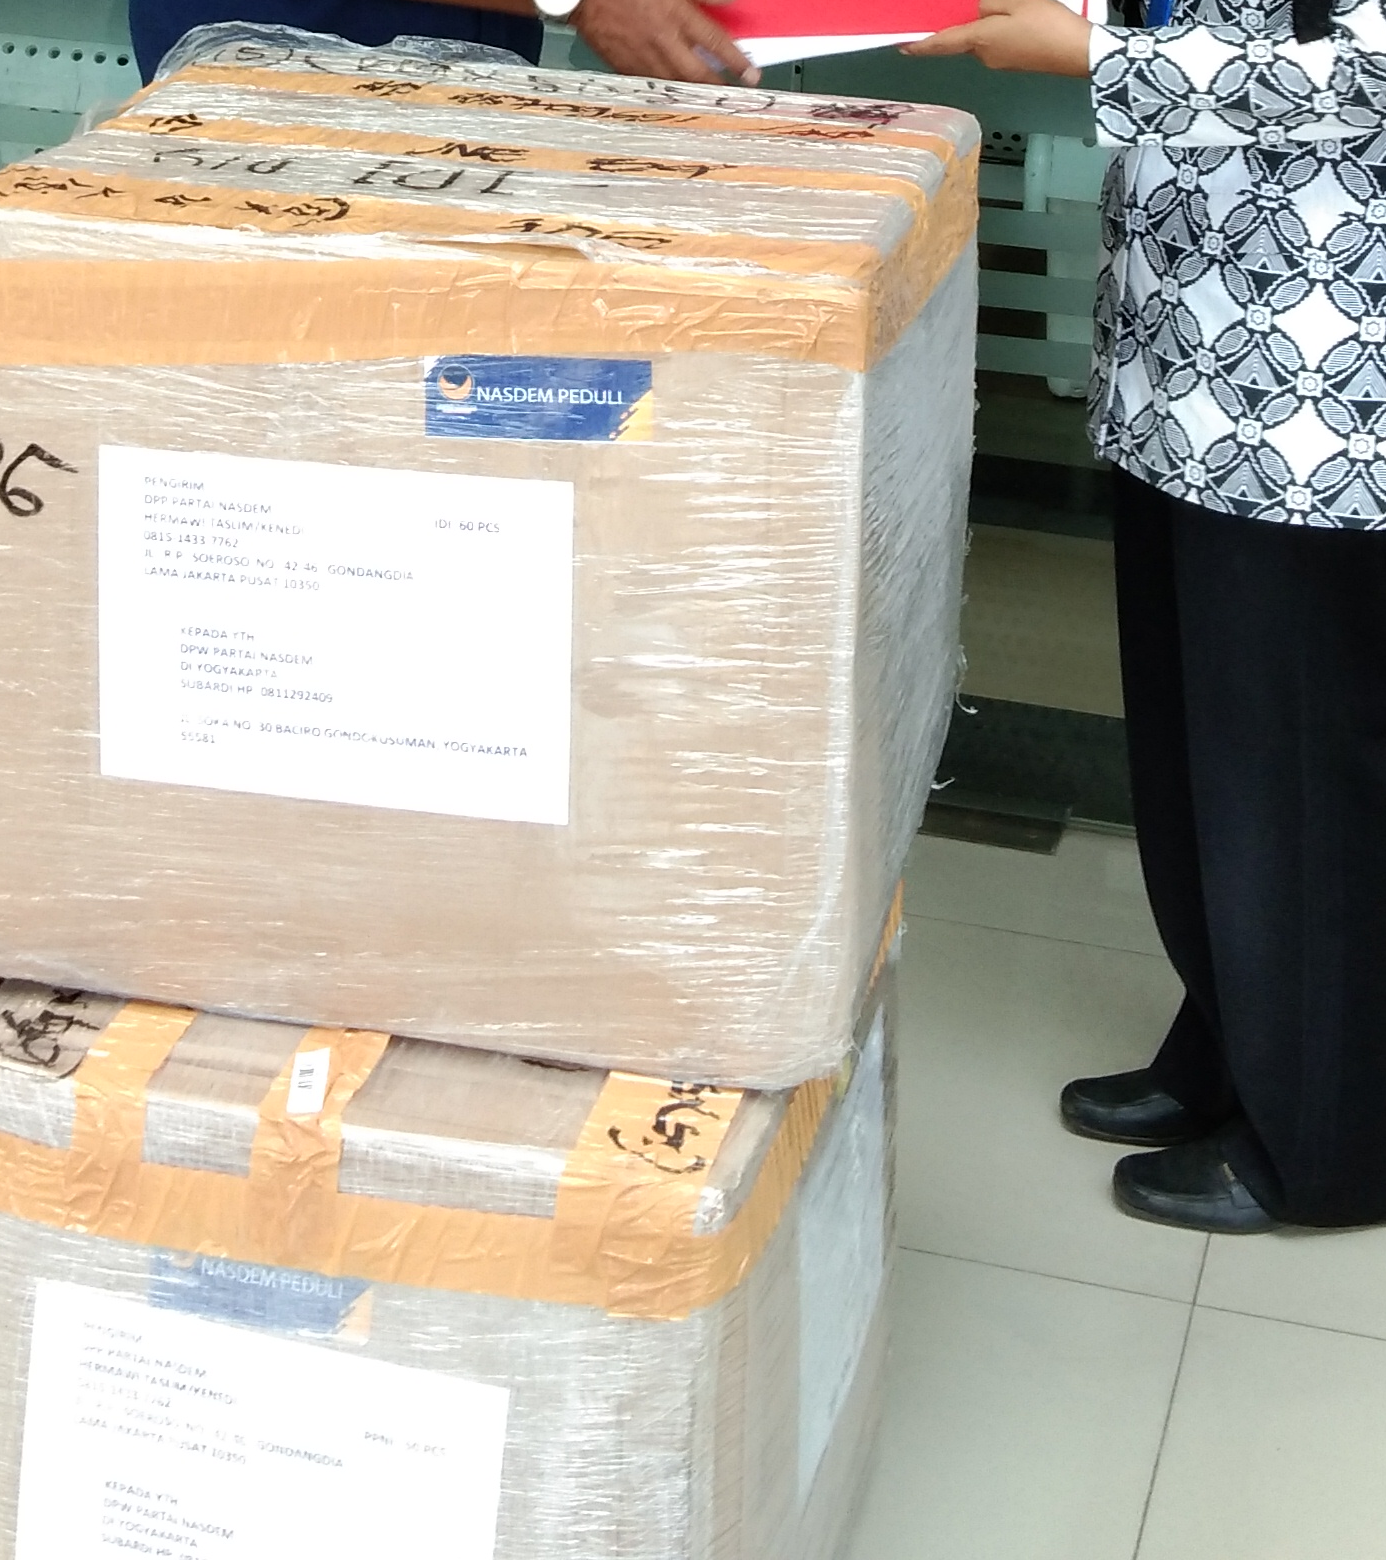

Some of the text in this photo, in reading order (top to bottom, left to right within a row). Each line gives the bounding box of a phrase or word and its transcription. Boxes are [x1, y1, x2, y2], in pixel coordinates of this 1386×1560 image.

[477, 387, 622, 404] NASDEM PEDULI
[144, 494, 168, 505] DPP
[219, 501, 272, 514] NASDEM
[144, 567, 178, 578] LAMA
[183, 570, 236, 583] JAKARTA
[327, 564, 414, 581] GONDANGDIA
[180, 644, 313, 666] DPW PARTAI NASDEM
[443, 740, 527, 757] YOGYAKARTA
[201, 1258, 276, 1288] NASDEM
